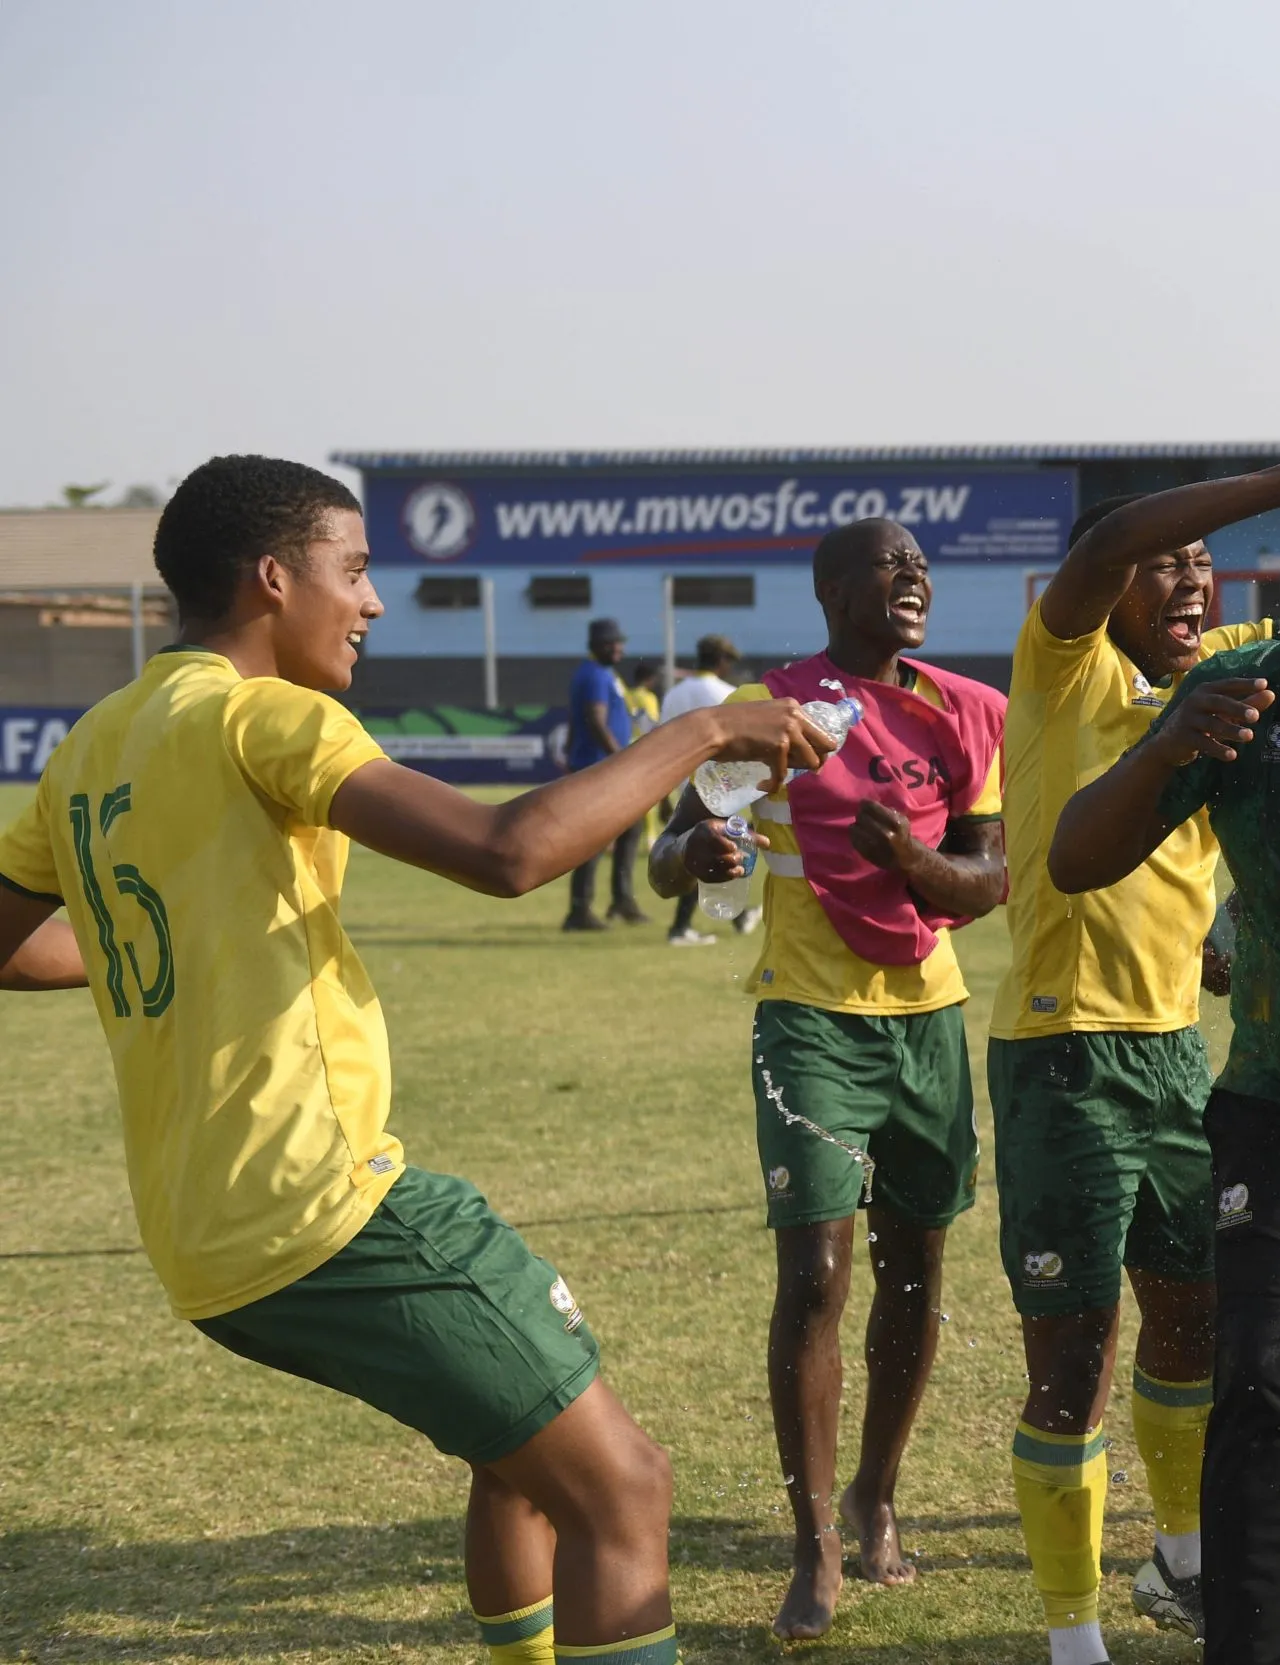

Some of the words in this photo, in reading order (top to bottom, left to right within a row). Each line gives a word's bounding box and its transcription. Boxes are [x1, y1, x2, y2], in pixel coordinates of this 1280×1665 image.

[498, 480, 968, 539] www.mwosfc.co.zw
[0, 718, 68, 773] FA
[69, 782, 175, 1018] 15
